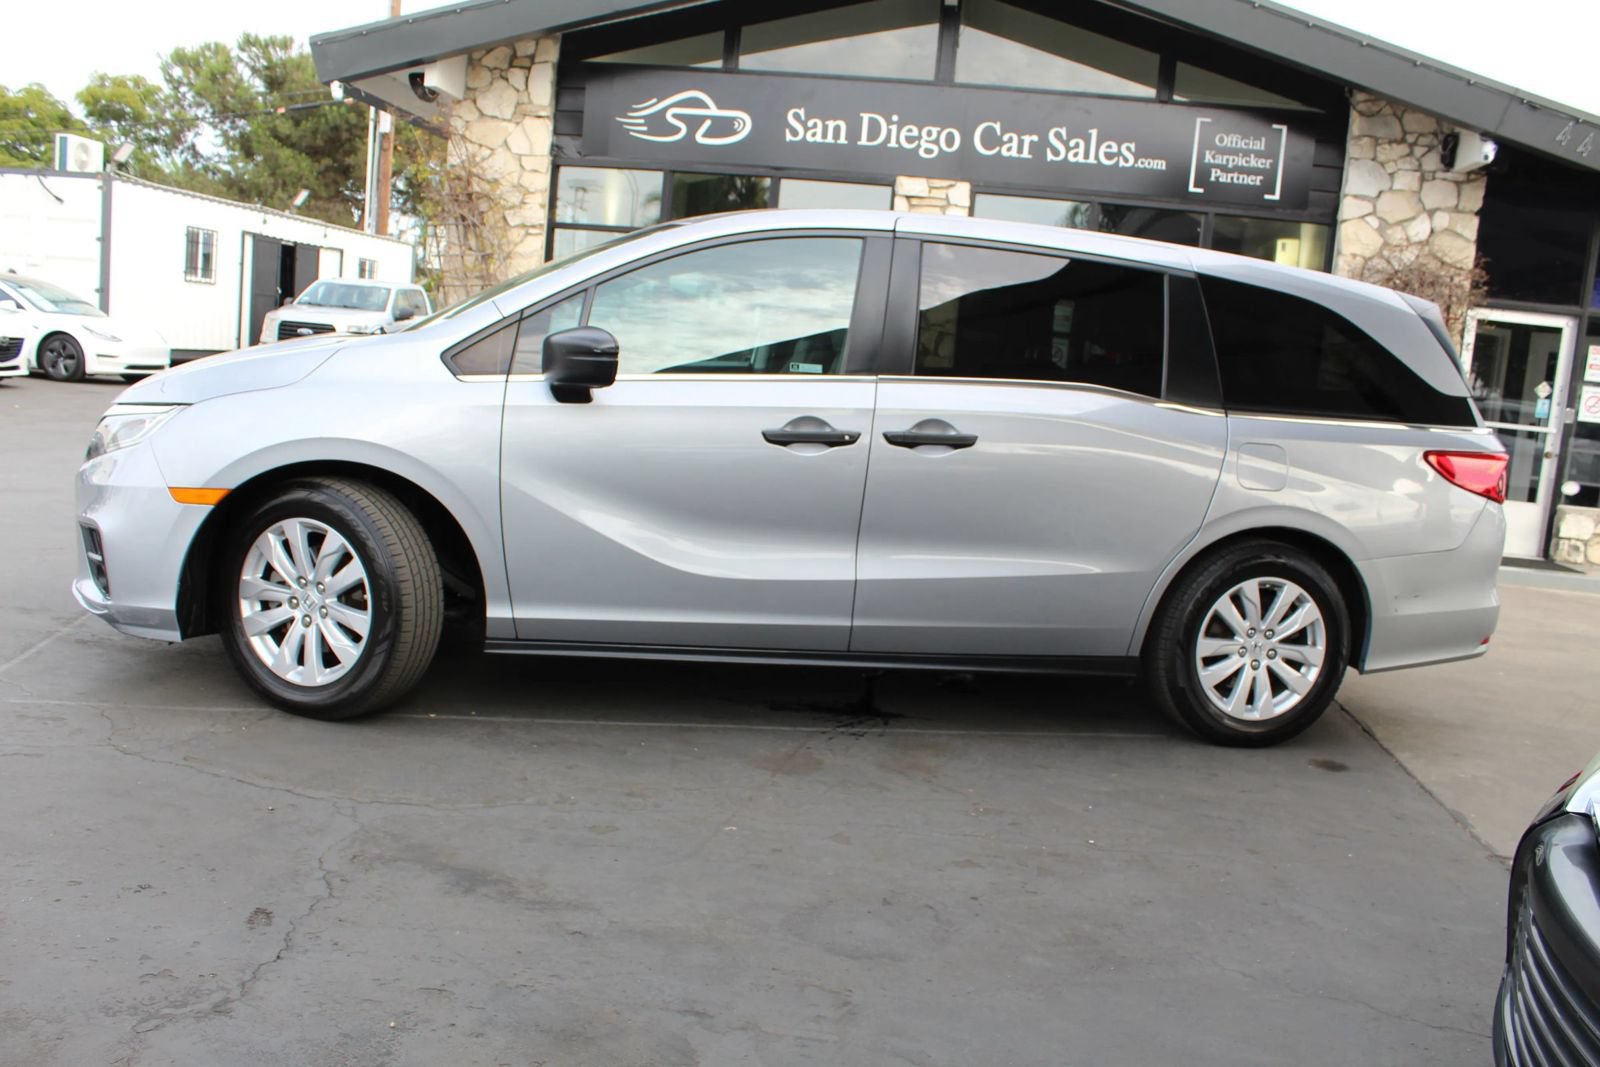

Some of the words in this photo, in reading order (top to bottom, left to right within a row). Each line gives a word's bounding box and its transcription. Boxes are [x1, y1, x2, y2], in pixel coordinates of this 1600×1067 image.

[785, 107, 849, 145] San
[856, 112, 962, 159] Diego
[973, 121, 1039, 160] Car
[1215, 133, 1266, 151] Official
[1204, 150, 1273, 169] Karpicker
[1209, 168, 1264, 186] Partner
